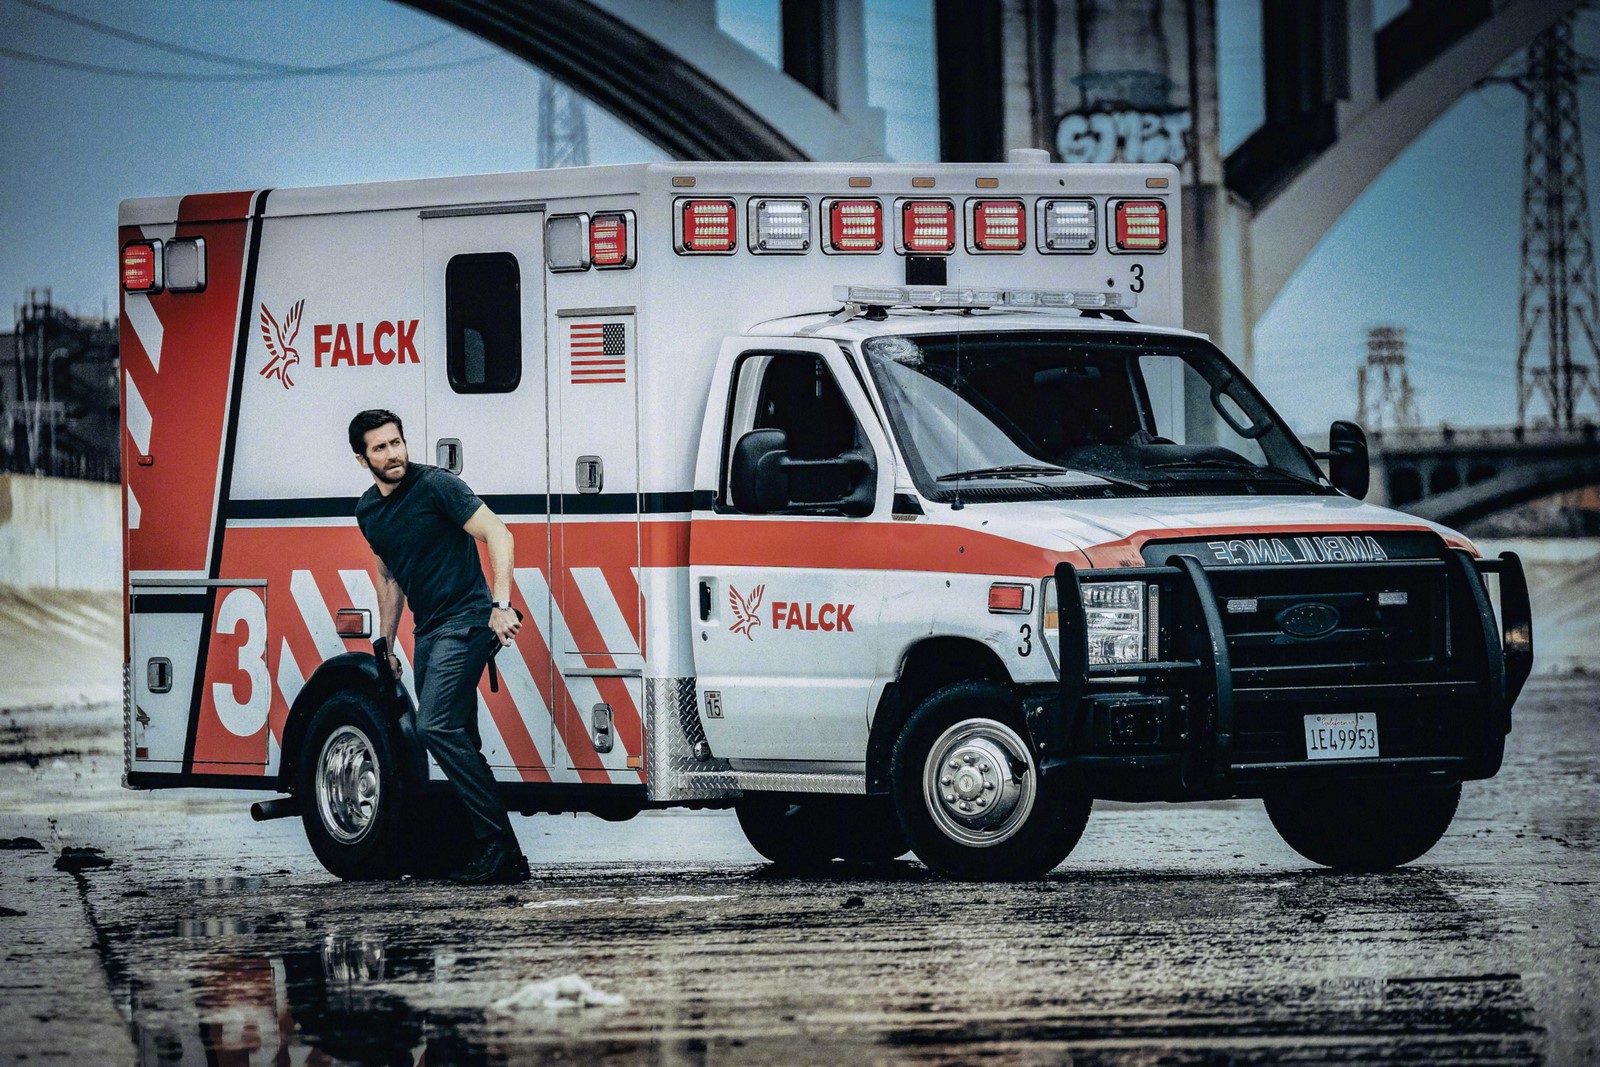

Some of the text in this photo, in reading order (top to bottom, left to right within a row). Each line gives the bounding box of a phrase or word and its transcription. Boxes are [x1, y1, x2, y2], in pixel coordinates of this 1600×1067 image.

[1130, 264, 1144, 293] 3
[314, 319, 420, 368] FALCK
[772, 602, 854, 632] FALCK
[1018, 624, 1032, 657] 3
[212, 588, 272, 737] 3
[707, 699, 721, 716] 15
[1321, 717, 1355, 727] California
[1311, 728, 1375, 750] 1E49953
